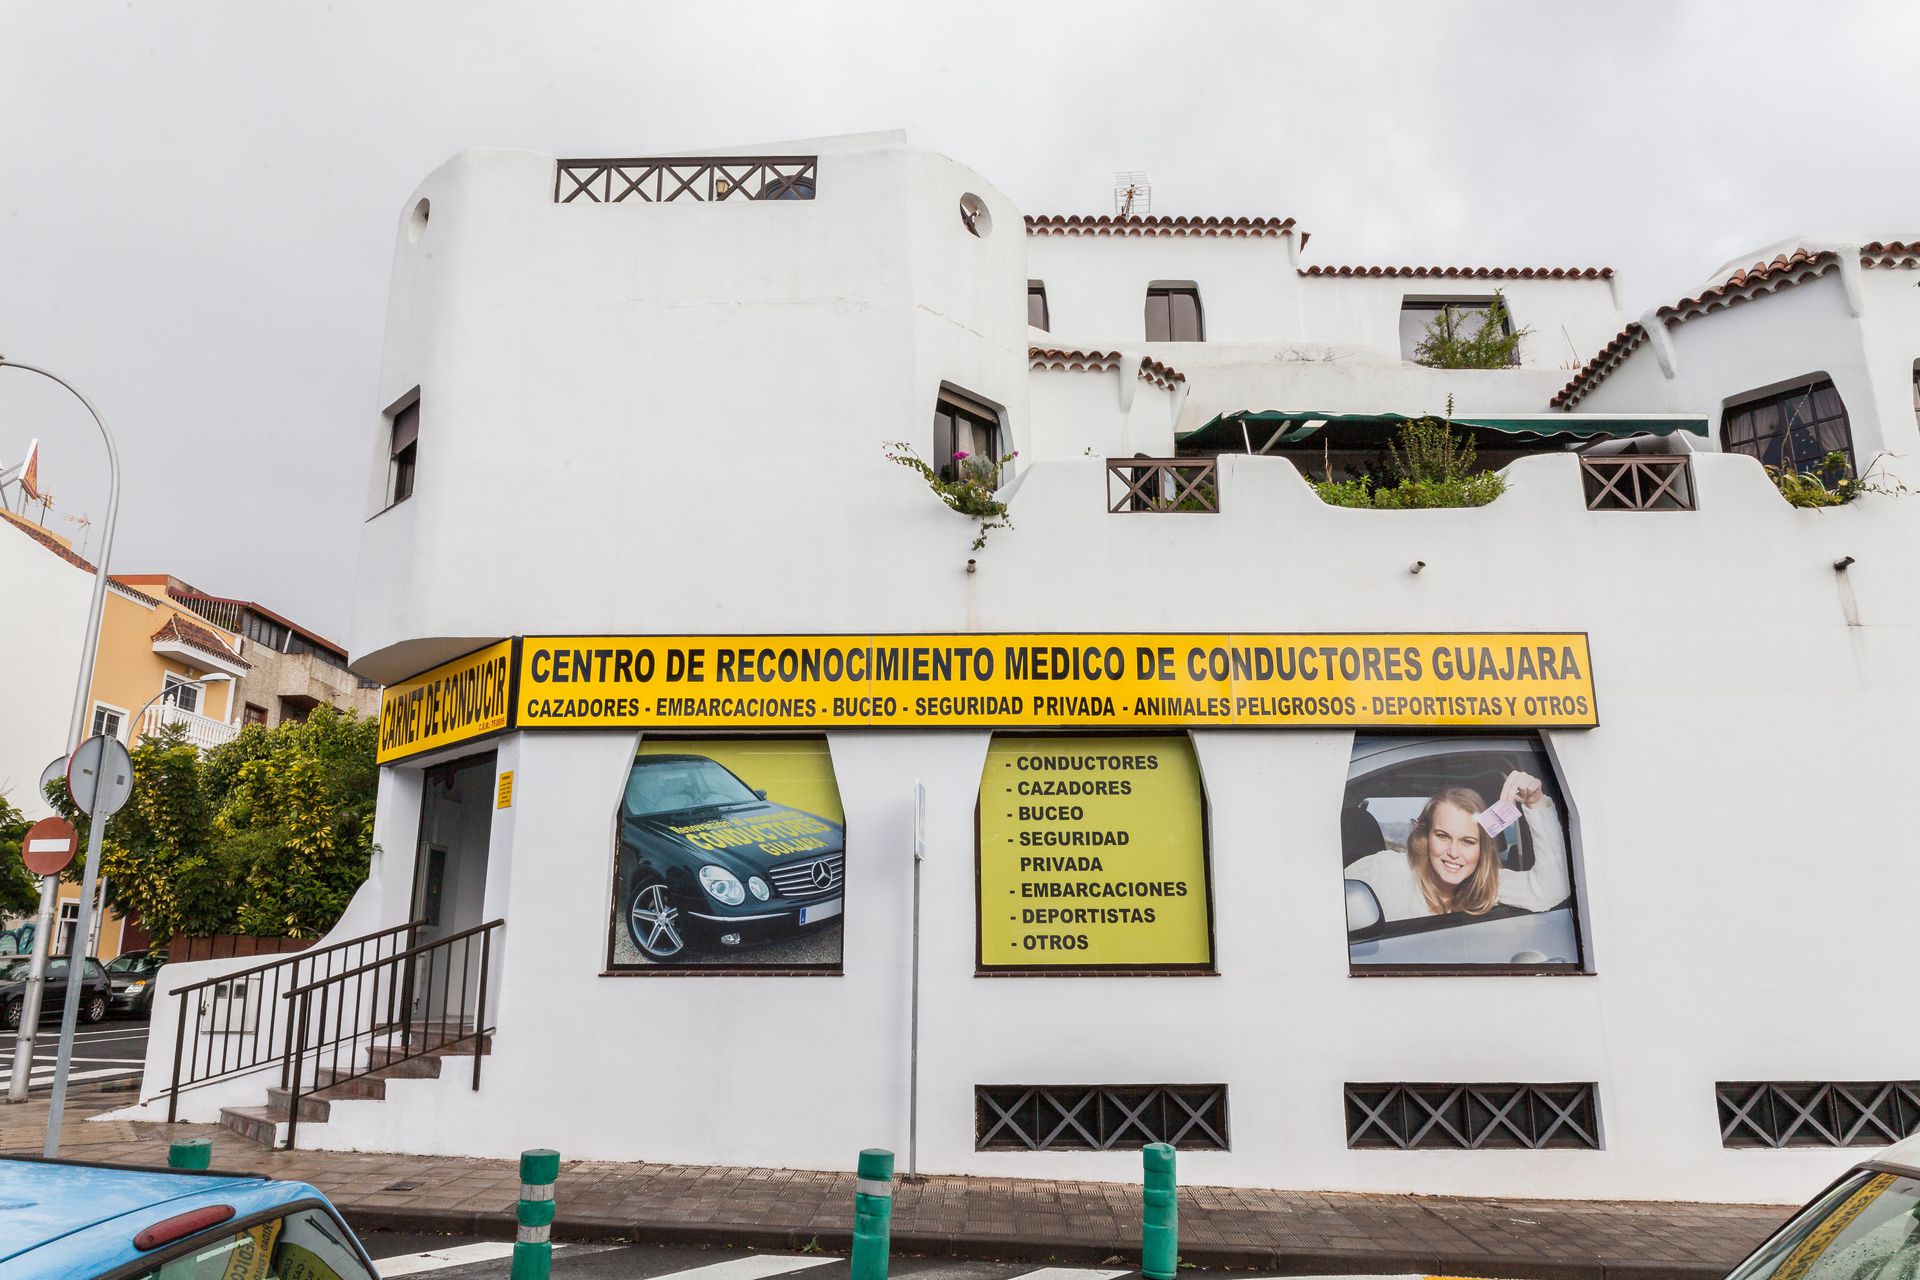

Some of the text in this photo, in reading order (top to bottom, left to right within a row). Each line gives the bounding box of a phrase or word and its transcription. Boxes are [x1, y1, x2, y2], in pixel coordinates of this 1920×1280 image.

[532, 646, 1581, 684] CENTRO DE RECONOCIMIENTO MEDICO DE CONDUCTORES GUAJARA
[381, 656, 506, 752] CARNET DE CONDUCIR
[527, 697, 639, 718] CAZADORES
[656, 697, 816, 718] EMBARCACIONES
[833, 696, 897, 717] BUCEO
[915, 696, 1023, 716] SEGURIDAD
[1034, 696, 1116, 717] PRIVADA
[1134, 696, 1231, 717] ANIMALES
[1236, 696, 1356, 717] PELIGROSOS
[1372, 696, 1503, 716] DEPORTISTAS
[1503, 697, 1517, 716] Y
[1524, 695, 1588, 716] OTROS
[1017, 754, 1158, 771] CONDUCTORES
[1017, 780, 1132, 796] CAZADORES
[1018, 806, 1084, 821] BUCEO
[686, 817, 831, 850] CONDUCTORES
[1019, 831, 1130, 847] SEGURIDAD
[758, 837, 828, 856] GUAJARA
[1020, 856, 1103, 872] PRIVADA
[1021, 881, 1188, 898] EMBARCACIONES
[1022, 907, 1156, 924] DEPORTISTAS
[1023, 934, 1089, 951] OTROS
